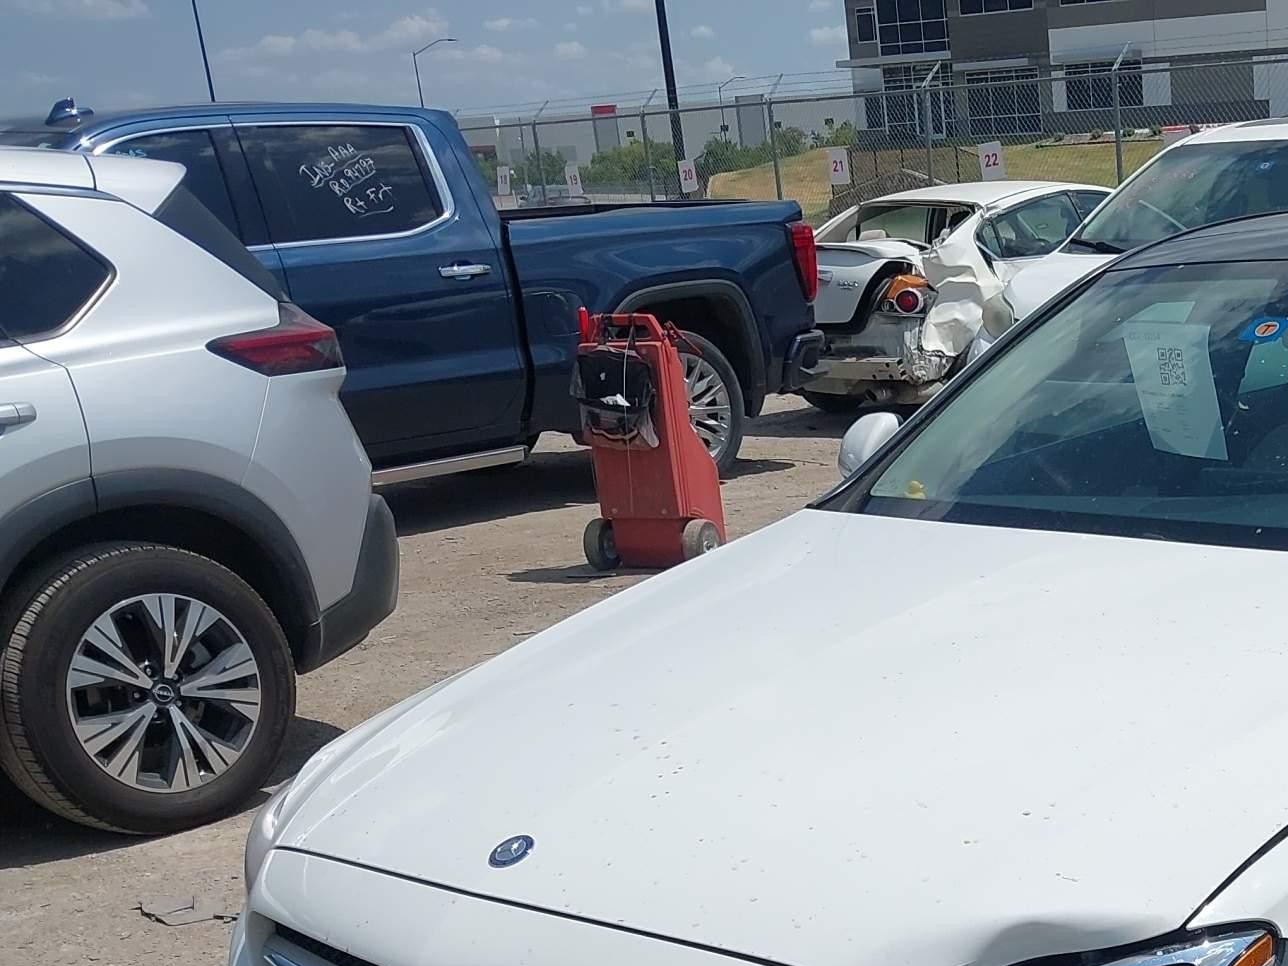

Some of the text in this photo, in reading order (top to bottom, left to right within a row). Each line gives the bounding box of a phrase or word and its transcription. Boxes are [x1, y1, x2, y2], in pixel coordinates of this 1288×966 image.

[832, 160, 844, 172] 21
[984, 153, 999, 168] 22
[569, 174, 578, 185] 19
[682, 169, 693, 181] 20
